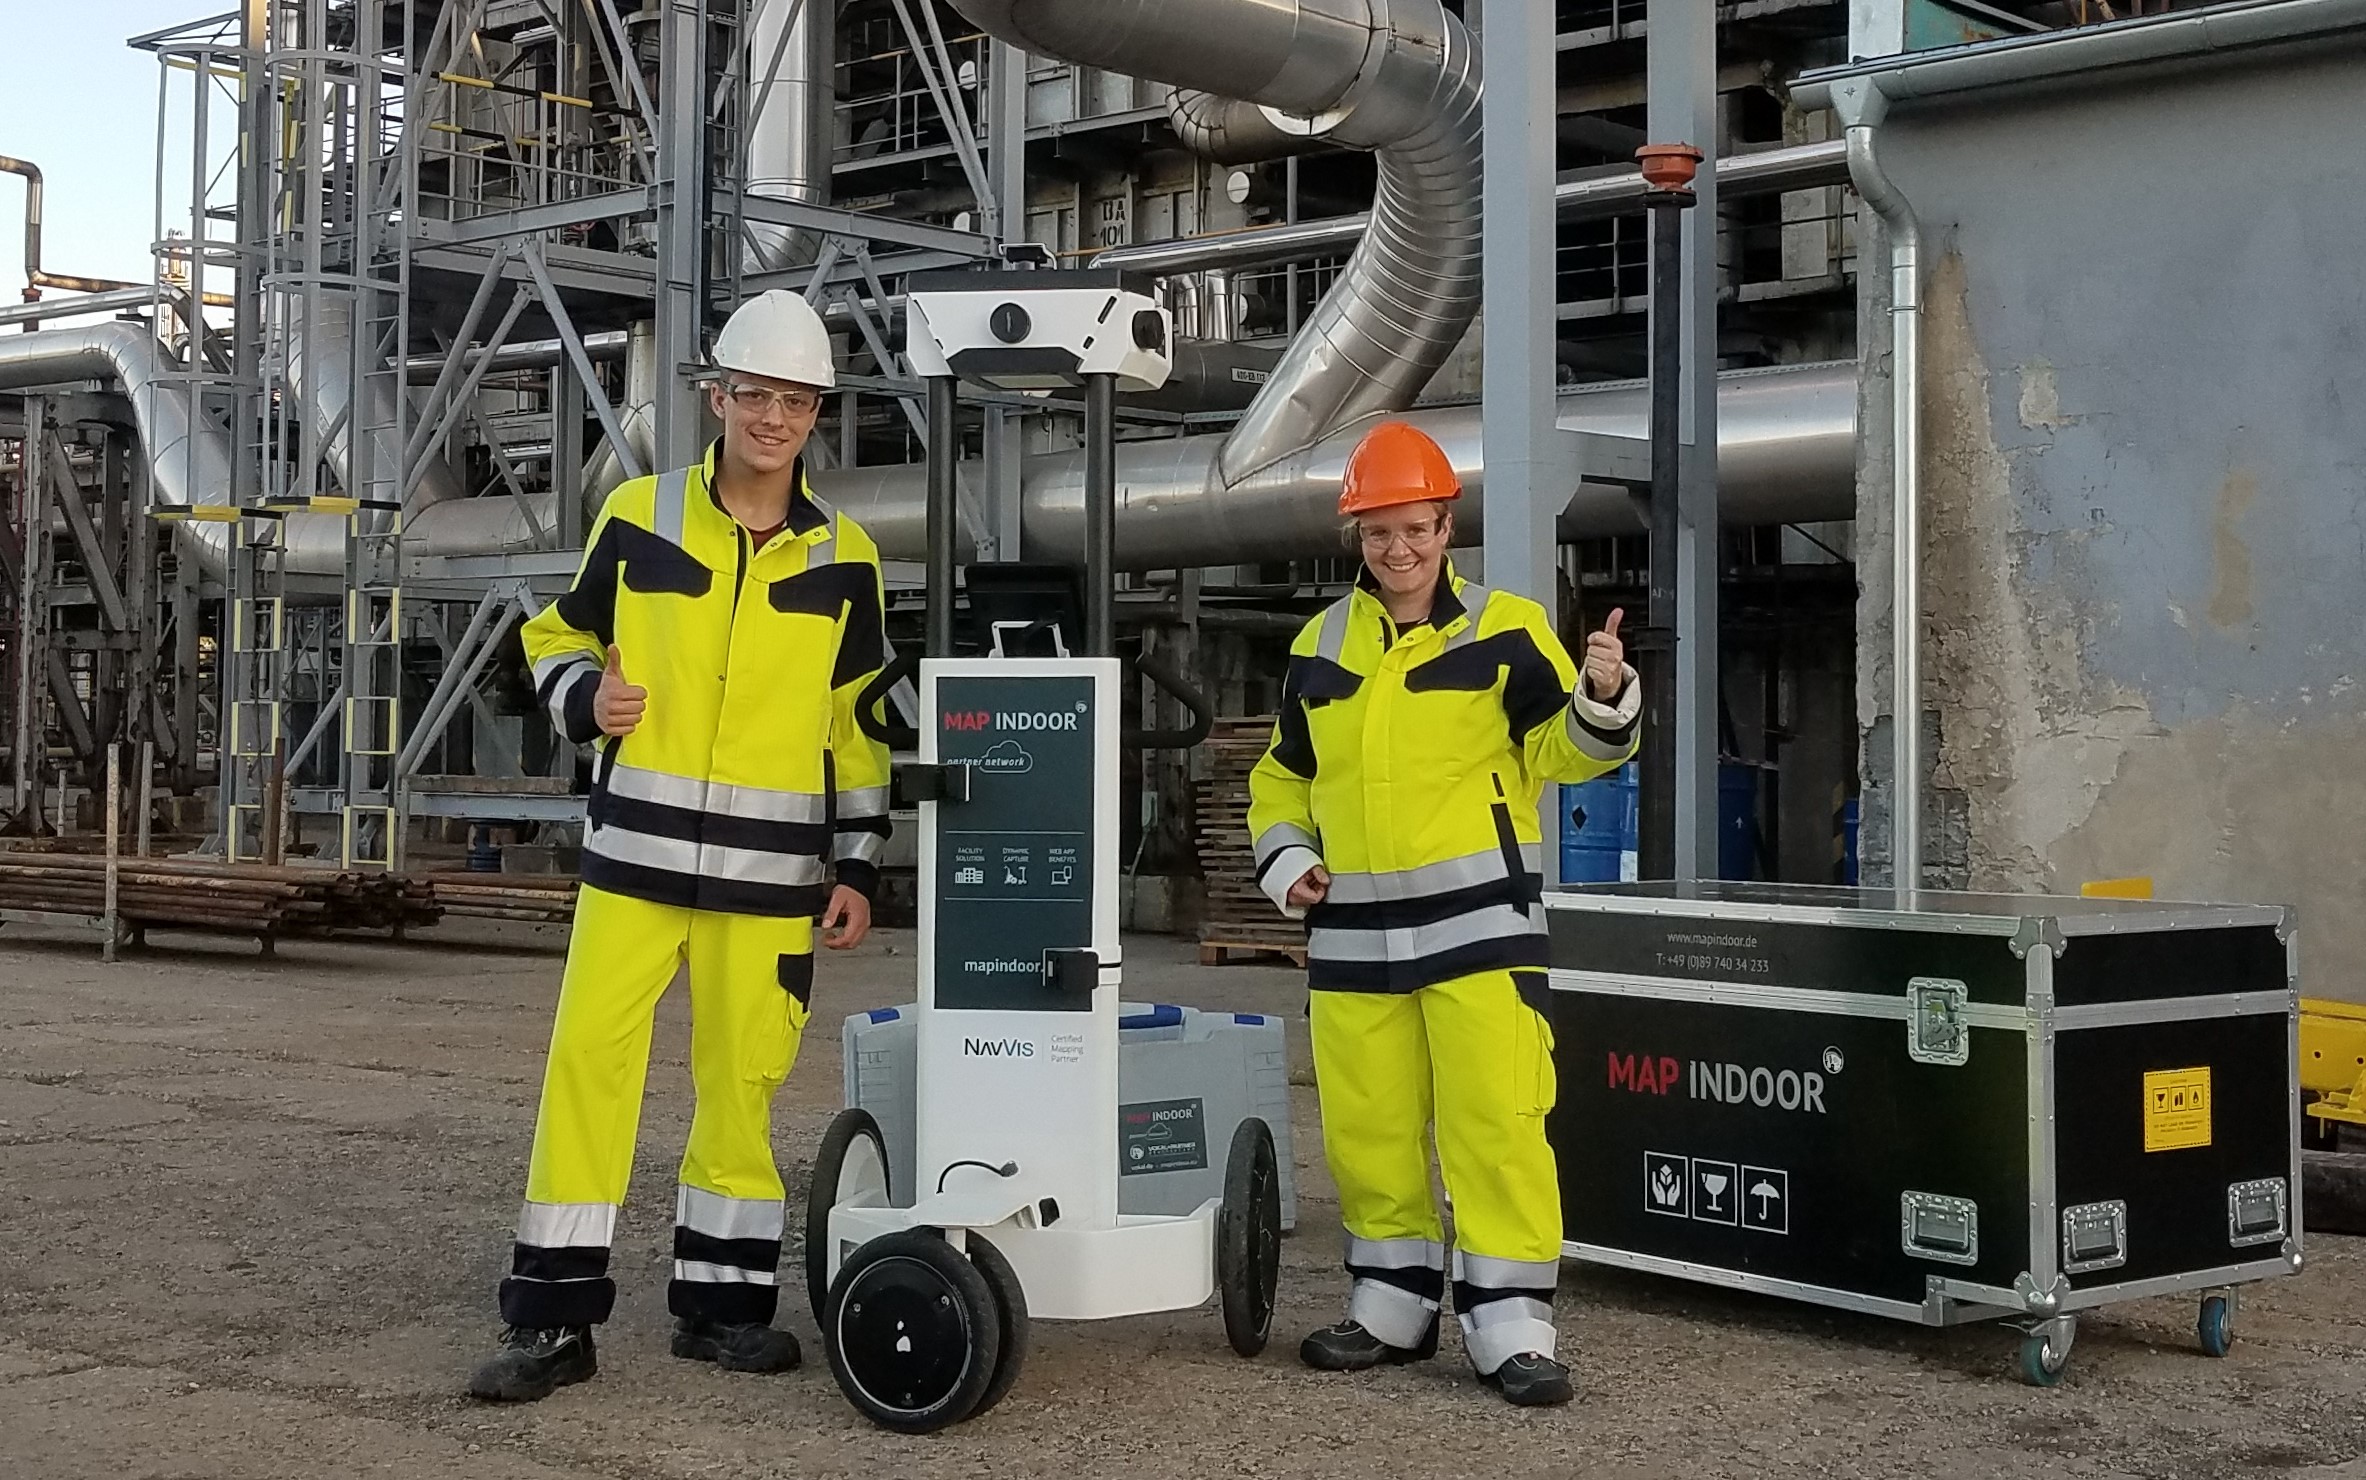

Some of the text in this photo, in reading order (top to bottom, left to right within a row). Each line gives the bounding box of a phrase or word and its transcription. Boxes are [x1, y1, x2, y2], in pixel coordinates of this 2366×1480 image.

[1100, 224, 1124, 248] 101
[944, 711, 1077, 730] MAP INDOOR
[985, 757, 1025, 766] network
[1666, 932, 1758, 948] www.mapindoor.de
[1667, 954, 1685, 967] +49
[1687, 954, 1712, 971] (0)89
[1714, 956, 1733, 971] 740
[1735, 958, 1748, 972] 34
[1750, 959, 1769, 973] 233
[1051, 1035, 1083, 1043] Certified
[1051, 1045, 1084, 1055] Mapping
[1051, 1054, 1079, 1063] Partner
[1608, 1051, 1827, 1114] MAP INDOOR
[1152, 1108, 1194, 1122] INDOOR
